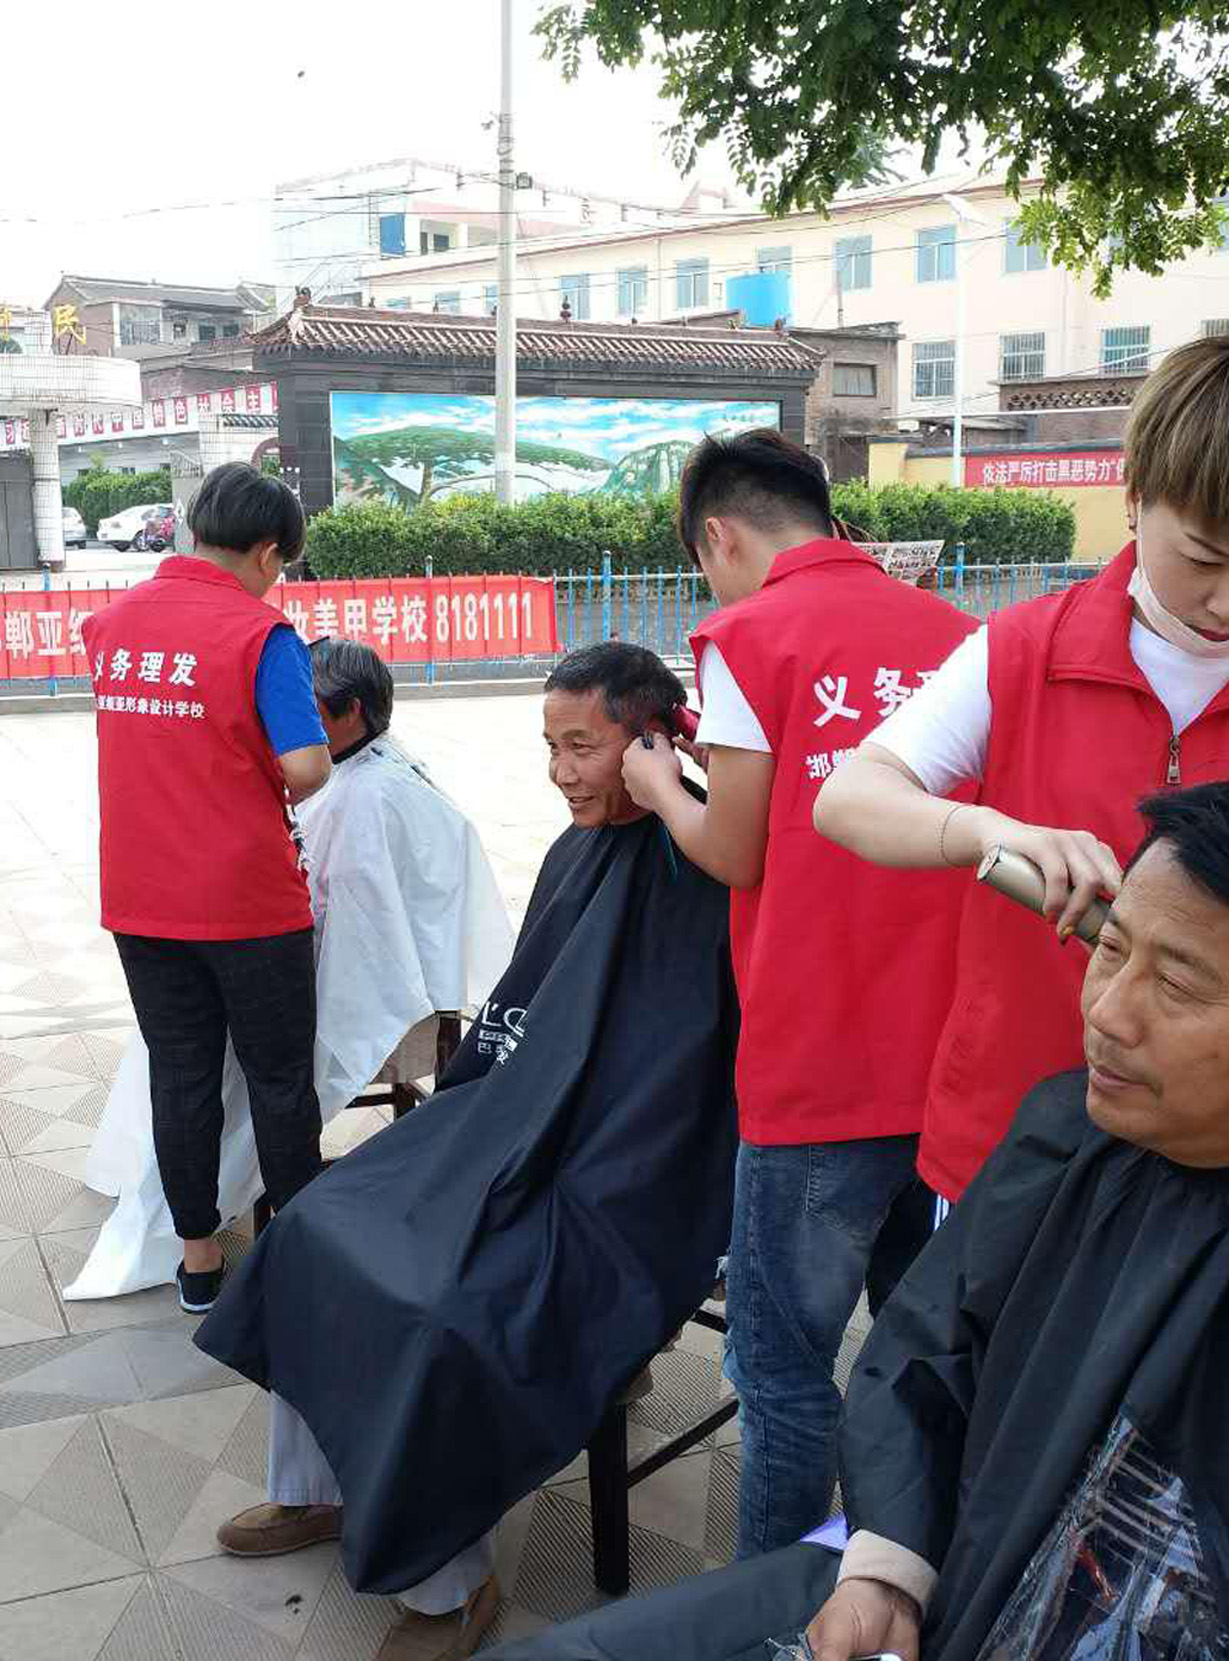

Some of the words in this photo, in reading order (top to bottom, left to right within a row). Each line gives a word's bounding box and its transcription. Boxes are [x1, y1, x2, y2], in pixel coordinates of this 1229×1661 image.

[95, 648, 198, 687] 义务理发
[813, 667, 938, 727] 义务
